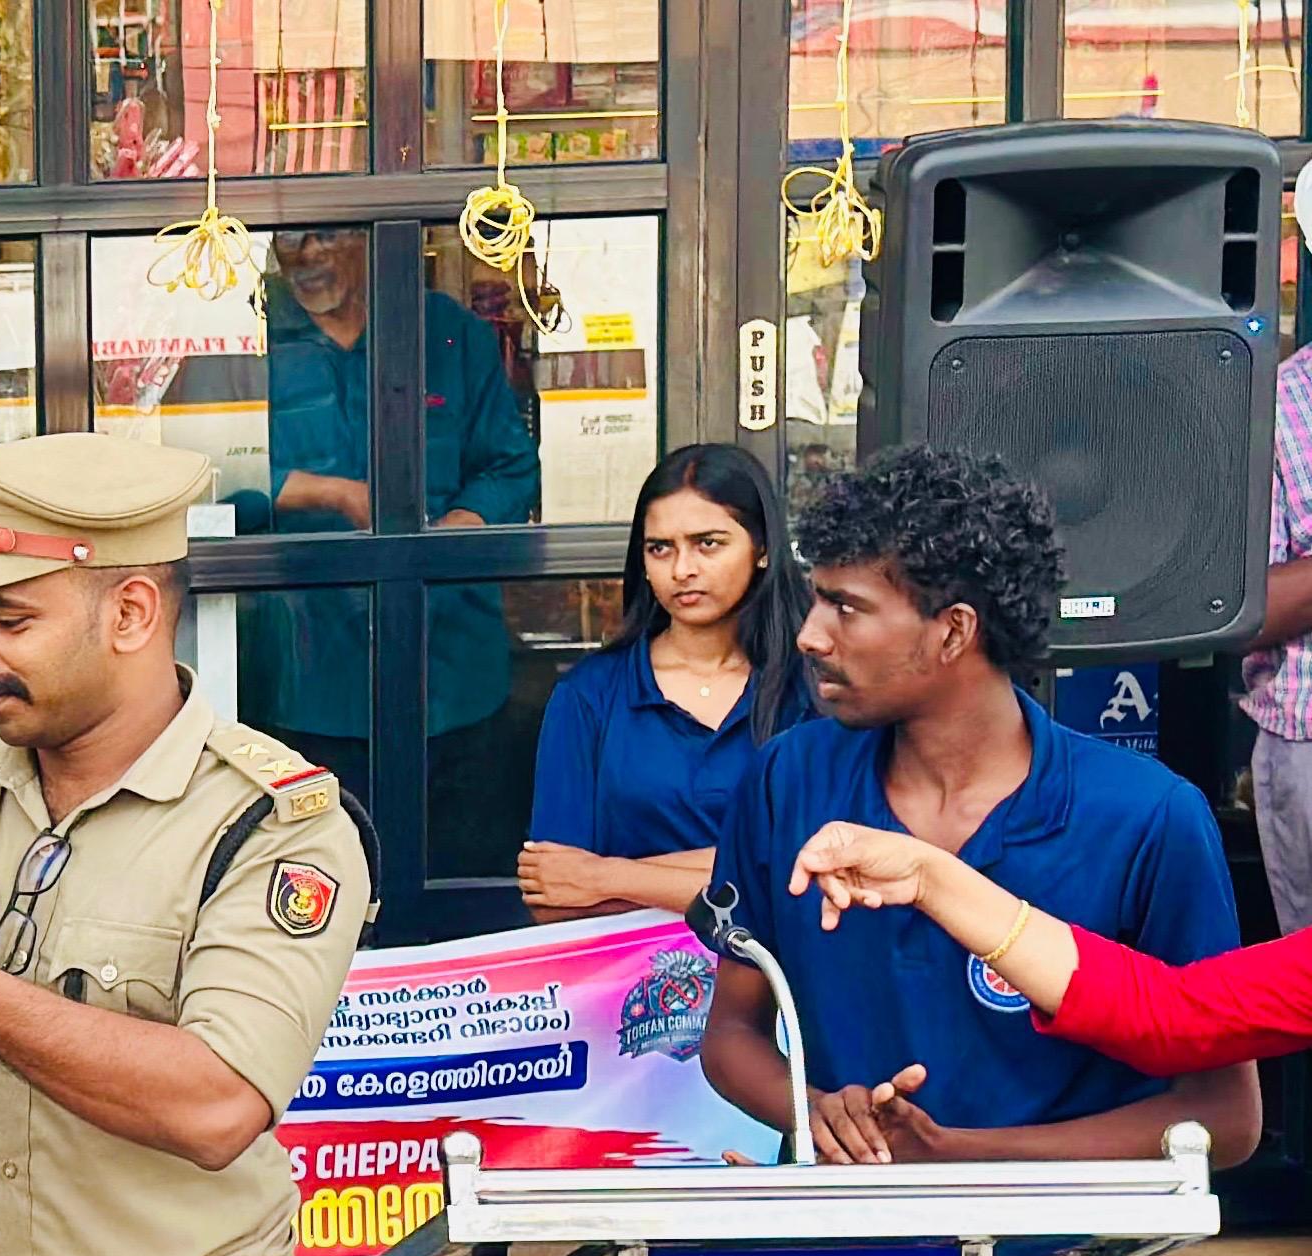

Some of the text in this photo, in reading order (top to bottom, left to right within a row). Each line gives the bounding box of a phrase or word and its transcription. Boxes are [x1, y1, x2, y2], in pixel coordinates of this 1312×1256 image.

[749, 330, 766, 421] PUSH
[359, 979, 487, 1008] സർക്കാർ
[466, 984, 560, 1017] വകുപ്പ്
[460, 1010, 571, 1039] വിഭാഗം)
[625, 1016, 666, 1045] TOOFAN
[336, 1043, 574, 1099] കേരളത്തിനായി
[315, 1137, 442, 1180] CHEPPA
